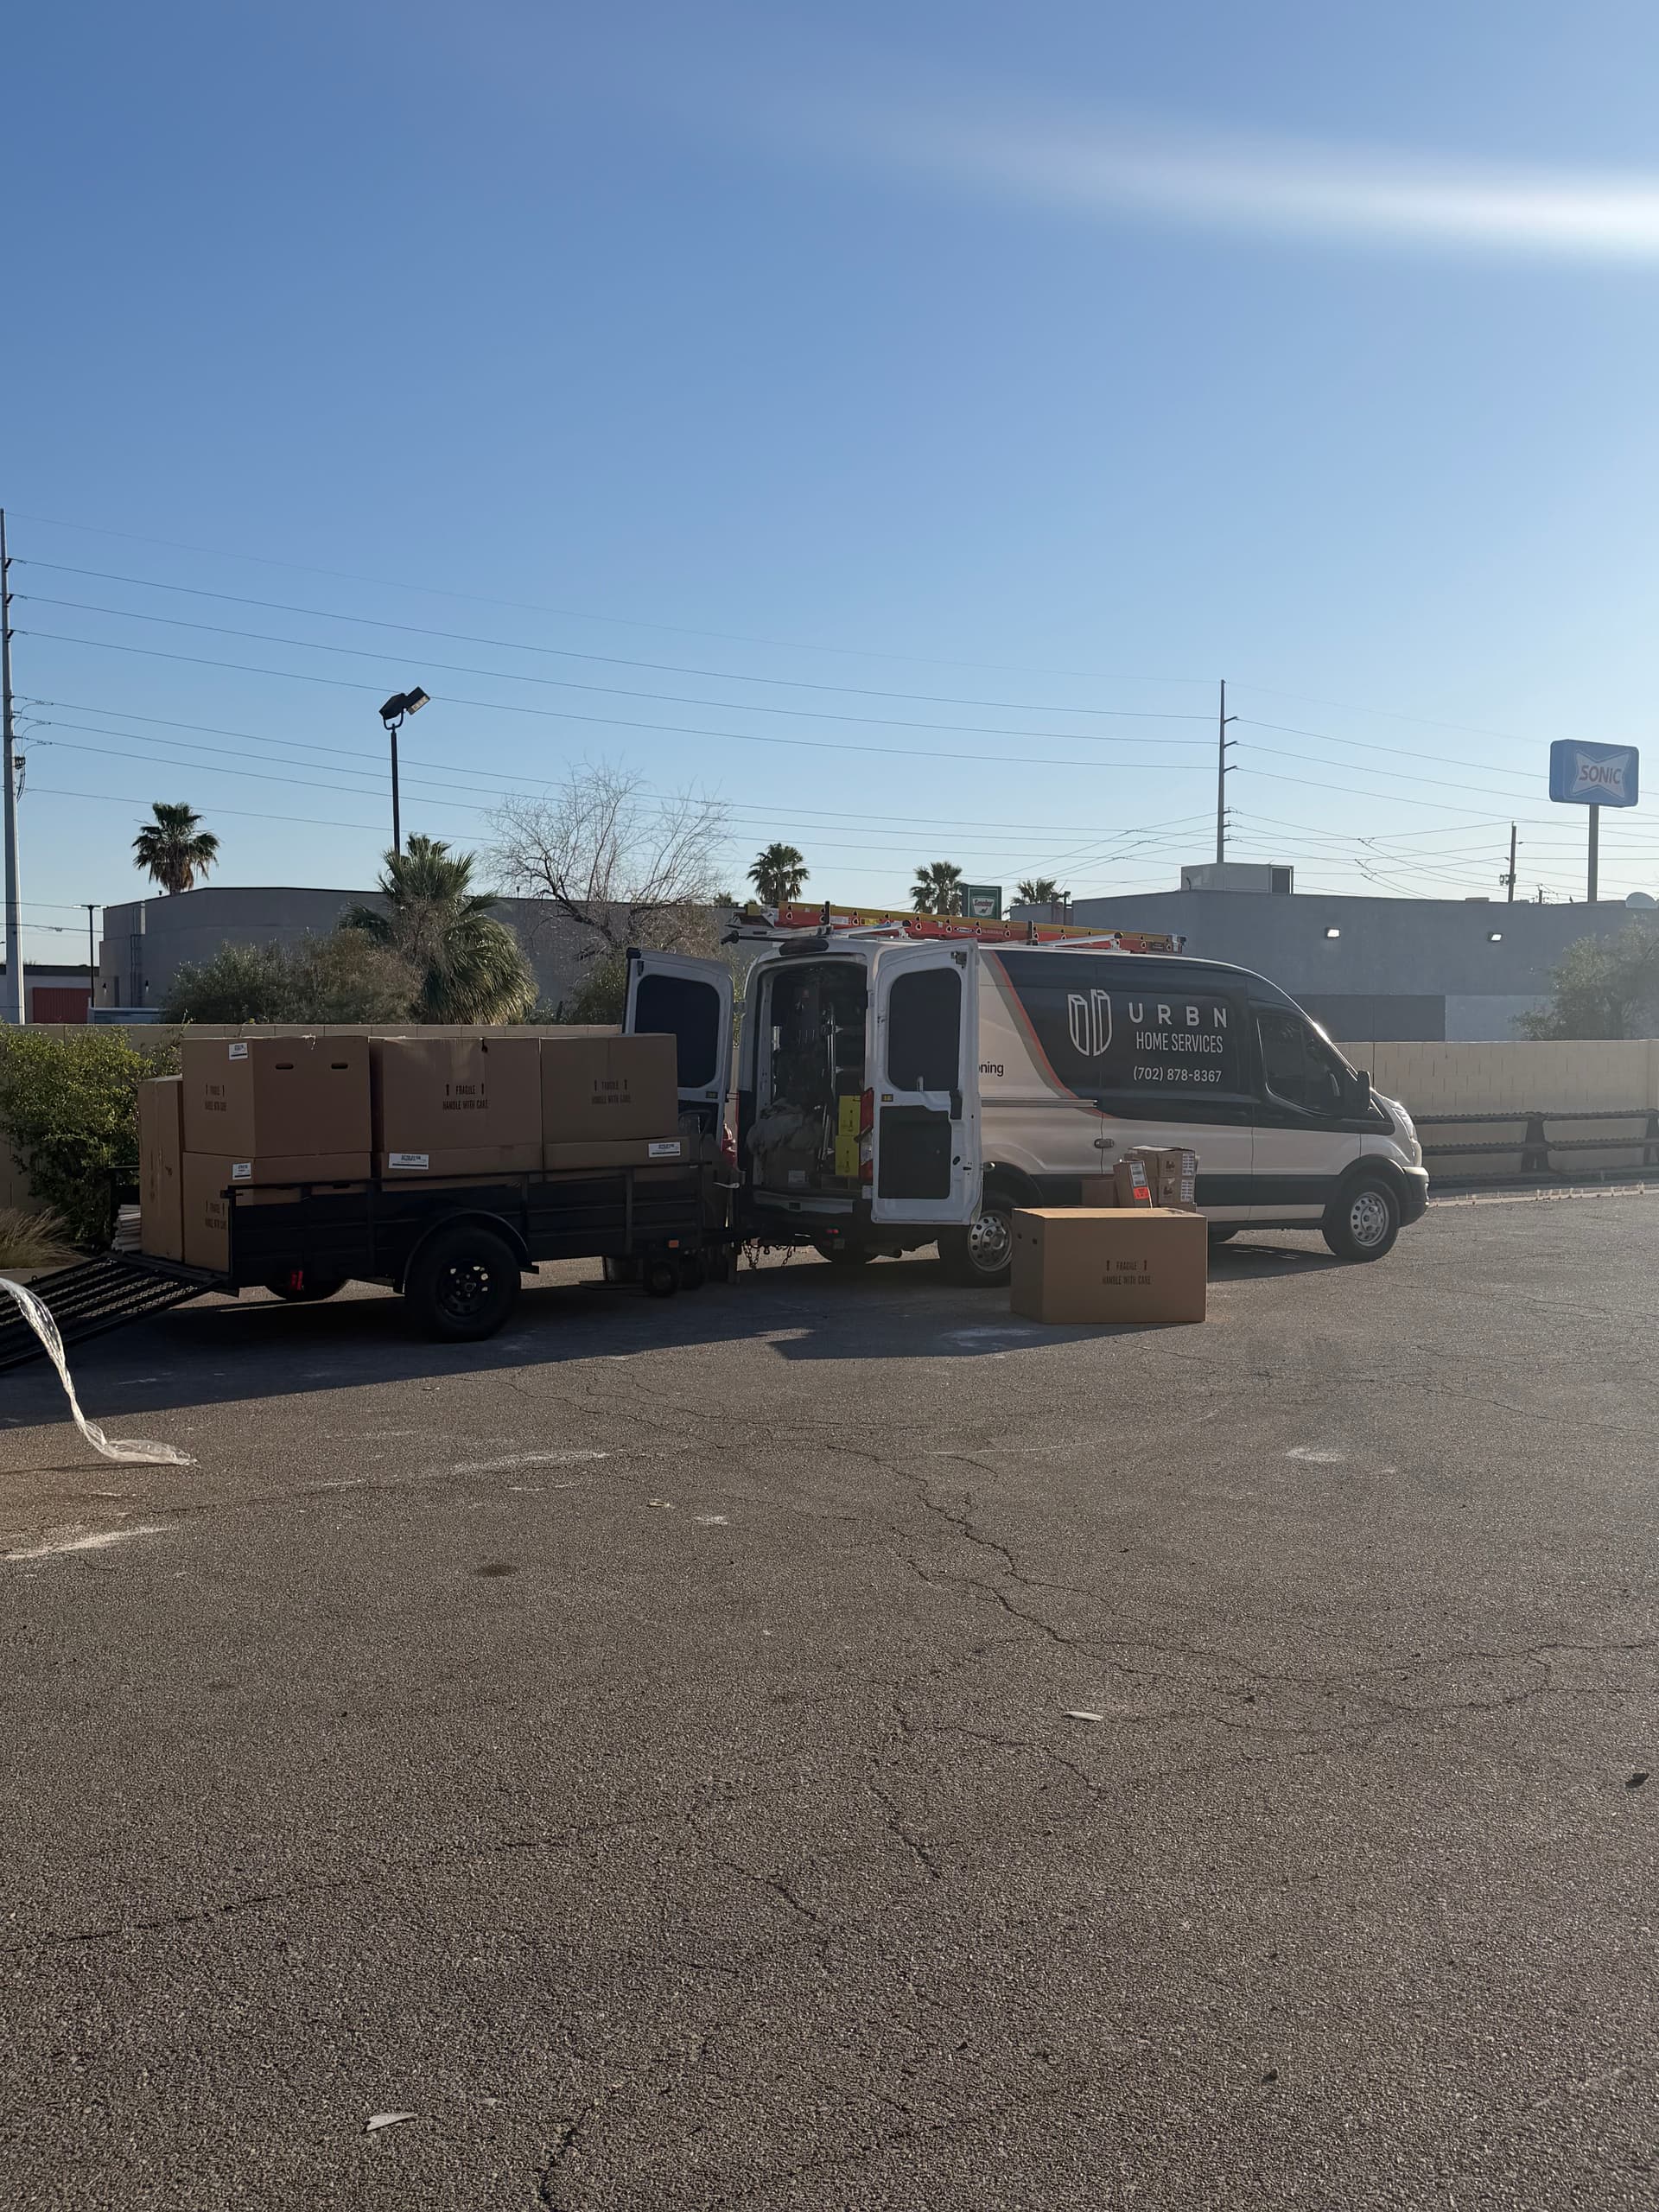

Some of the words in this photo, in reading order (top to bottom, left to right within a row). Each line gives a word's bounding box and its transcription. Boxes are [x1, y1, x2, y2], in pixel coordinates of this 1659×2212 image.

[1579, 764, 1622, 785] SONIC
[1128, 1001, 1228, 1028] URBN
[1136, 1031, 1169, 1051] HOME
[1171, 1033, 1224, 1053] SERVICES
[979, 1061, 1004, 1077] ning
[1134, 1065, 1163, 1082] (702)
[1166, 1068, 1223, 1083] 878-8367
[455, 1084, 476, 1095] FRAGILE
[442, 1100, 461, 1110] HANDLE
[462, 1100, 475, 1109] WITH
[1116, 1261, 1137, 1271] FRAGILE
[1102, 1275, 1122, 1286] HANDLE
[1123, 1275, 1136, 1285] WITH
